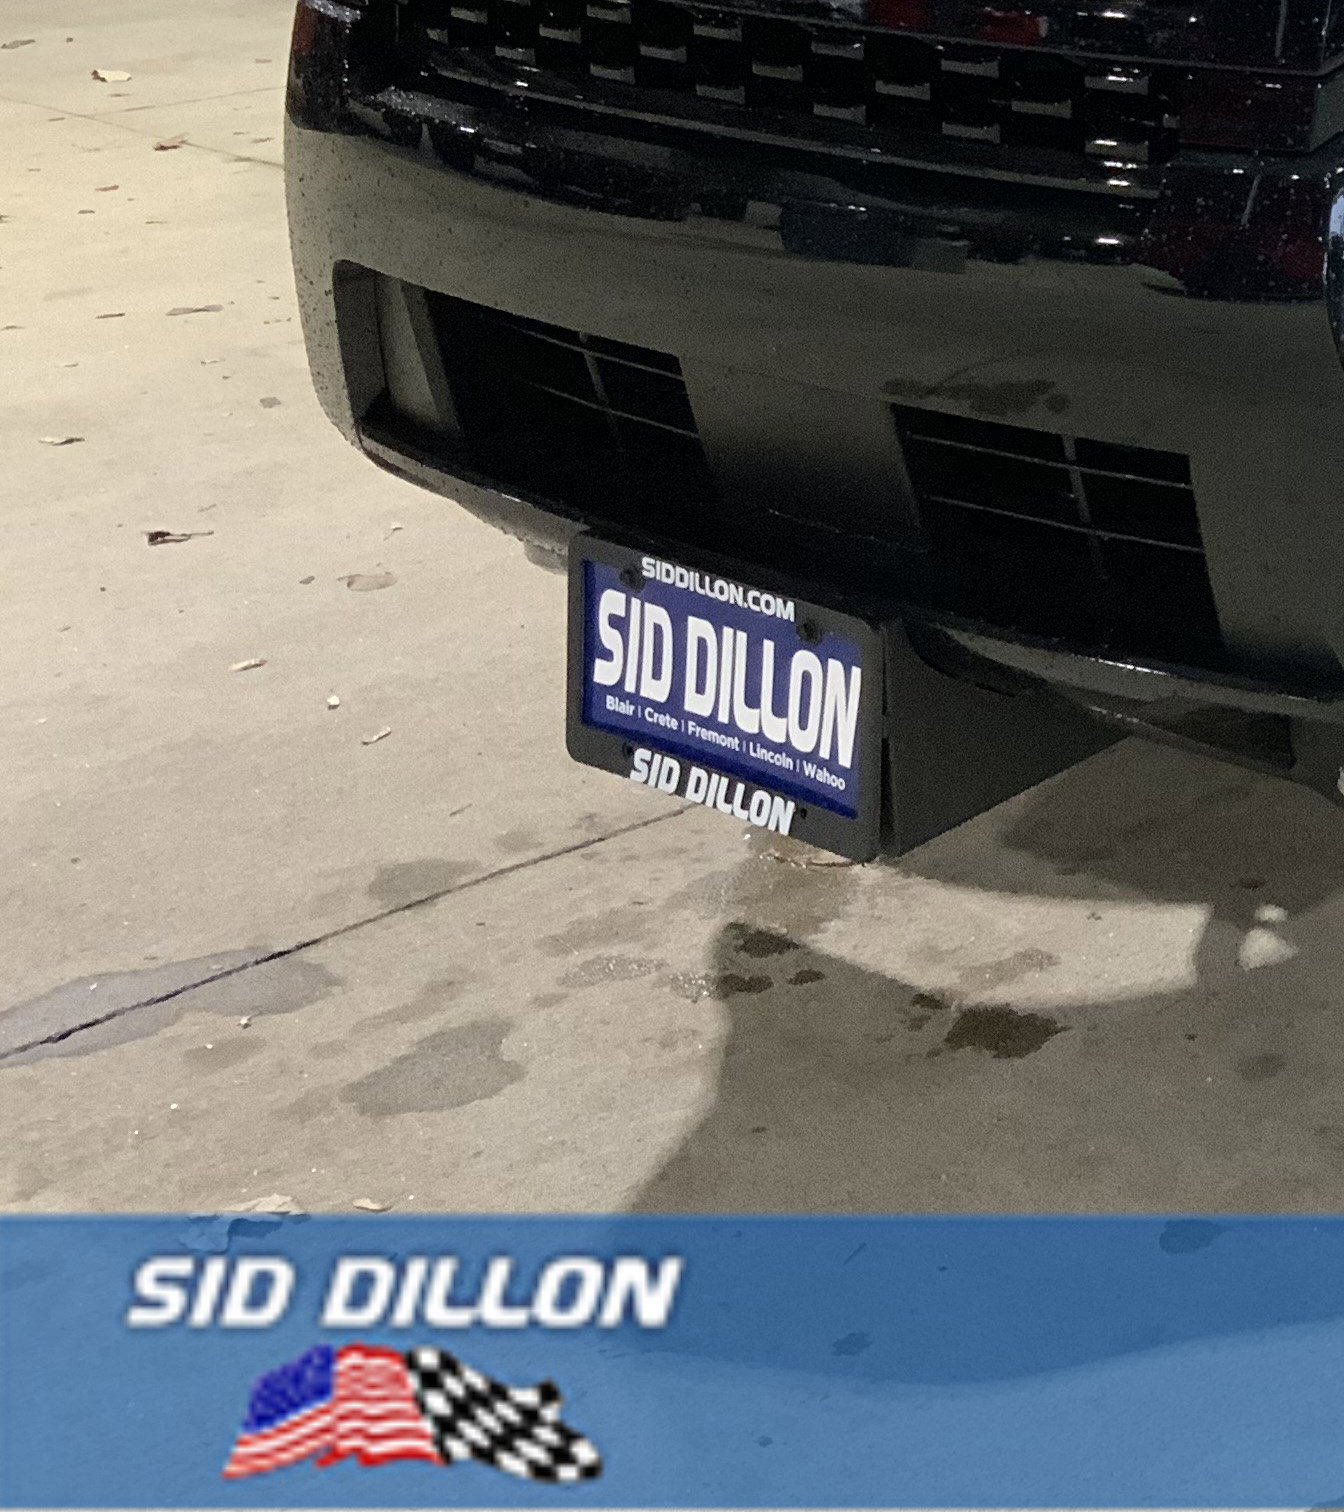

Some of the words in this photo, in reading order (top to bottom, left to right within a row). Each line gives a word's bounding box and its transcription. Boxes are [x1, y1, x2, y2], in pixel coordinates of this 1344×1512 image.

[641, 557, 796, 622] SIDDILLON.COM
[593, 588, 674, 703] SID
[684, 615, 863, 769] DILLON
[605, 695, 635, 718] Blair
[645, 707, 679, 731] Crete
[687, 721, 740, 752] Fremont
[749, 741, 794, 771] Lincoln
[802, 760, 847, 791] Wahoo
[630, 748, 681, 794] SID
[685, 766, 797, 836] DILLON
